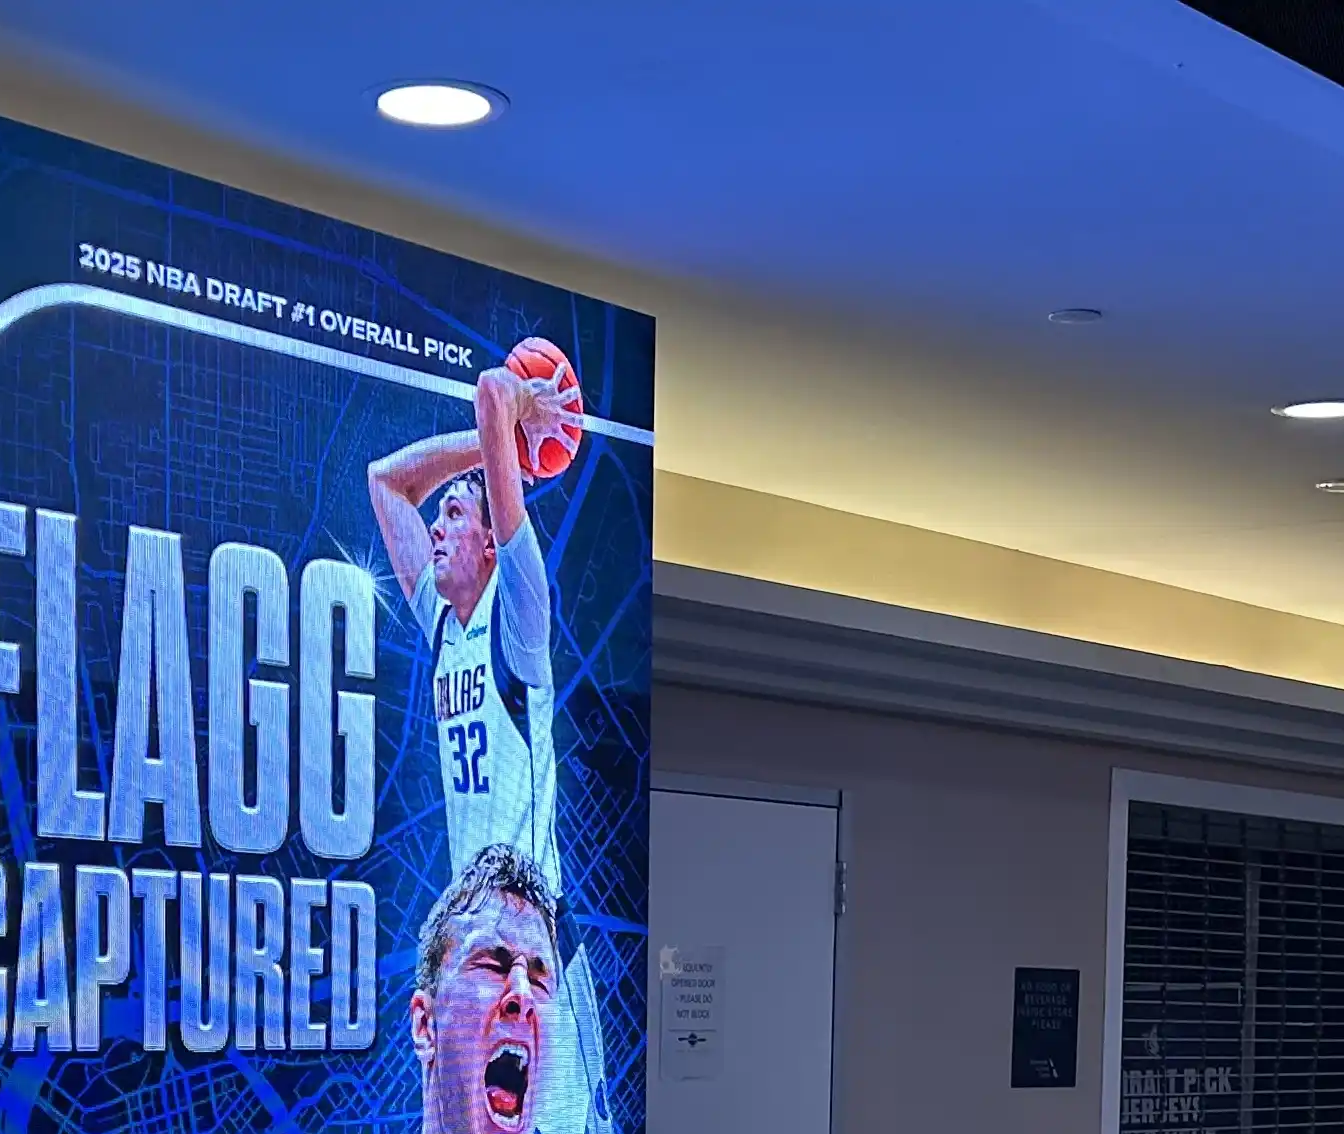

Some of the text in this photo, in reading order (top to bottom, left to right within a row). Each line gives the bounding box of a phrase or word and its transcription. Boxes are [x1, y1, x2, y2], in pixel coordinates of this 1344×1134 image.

[78, 243, 474, 369] 2025 NBA DRAFT #1 OVERALL PICK
[448, 720, 490, 795] 32
